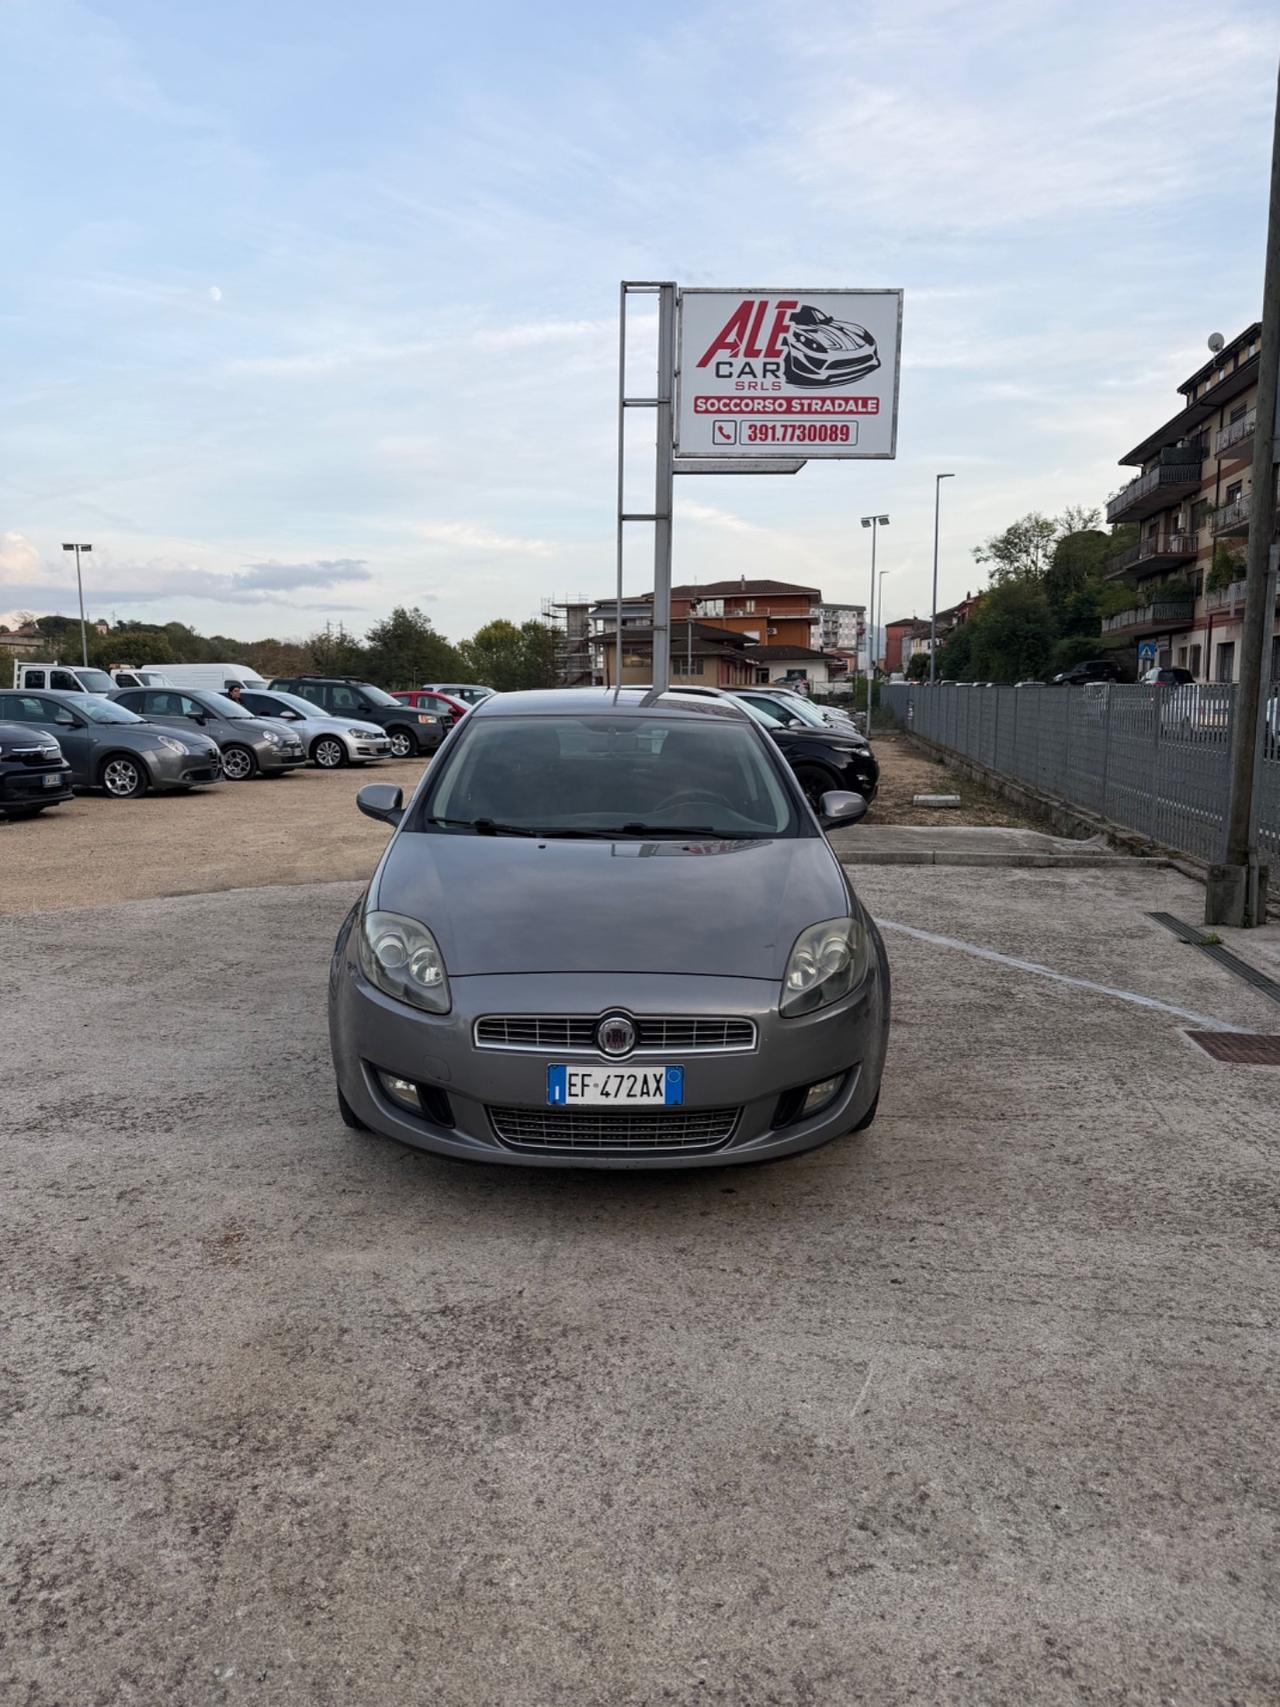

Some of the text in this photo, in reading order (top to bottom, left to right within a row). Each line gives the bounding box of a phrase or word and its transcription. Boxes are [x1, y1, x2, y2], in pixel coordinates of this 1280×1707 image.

[696, 300, 799, 368] ALE
[715, 361, 781, 378] CAR
[735, 381, 782, 391] SRLS
[696, 399, 878, 413] SOCCORSO STRADALE
[748, 424, 850, 442] 391.7730089
